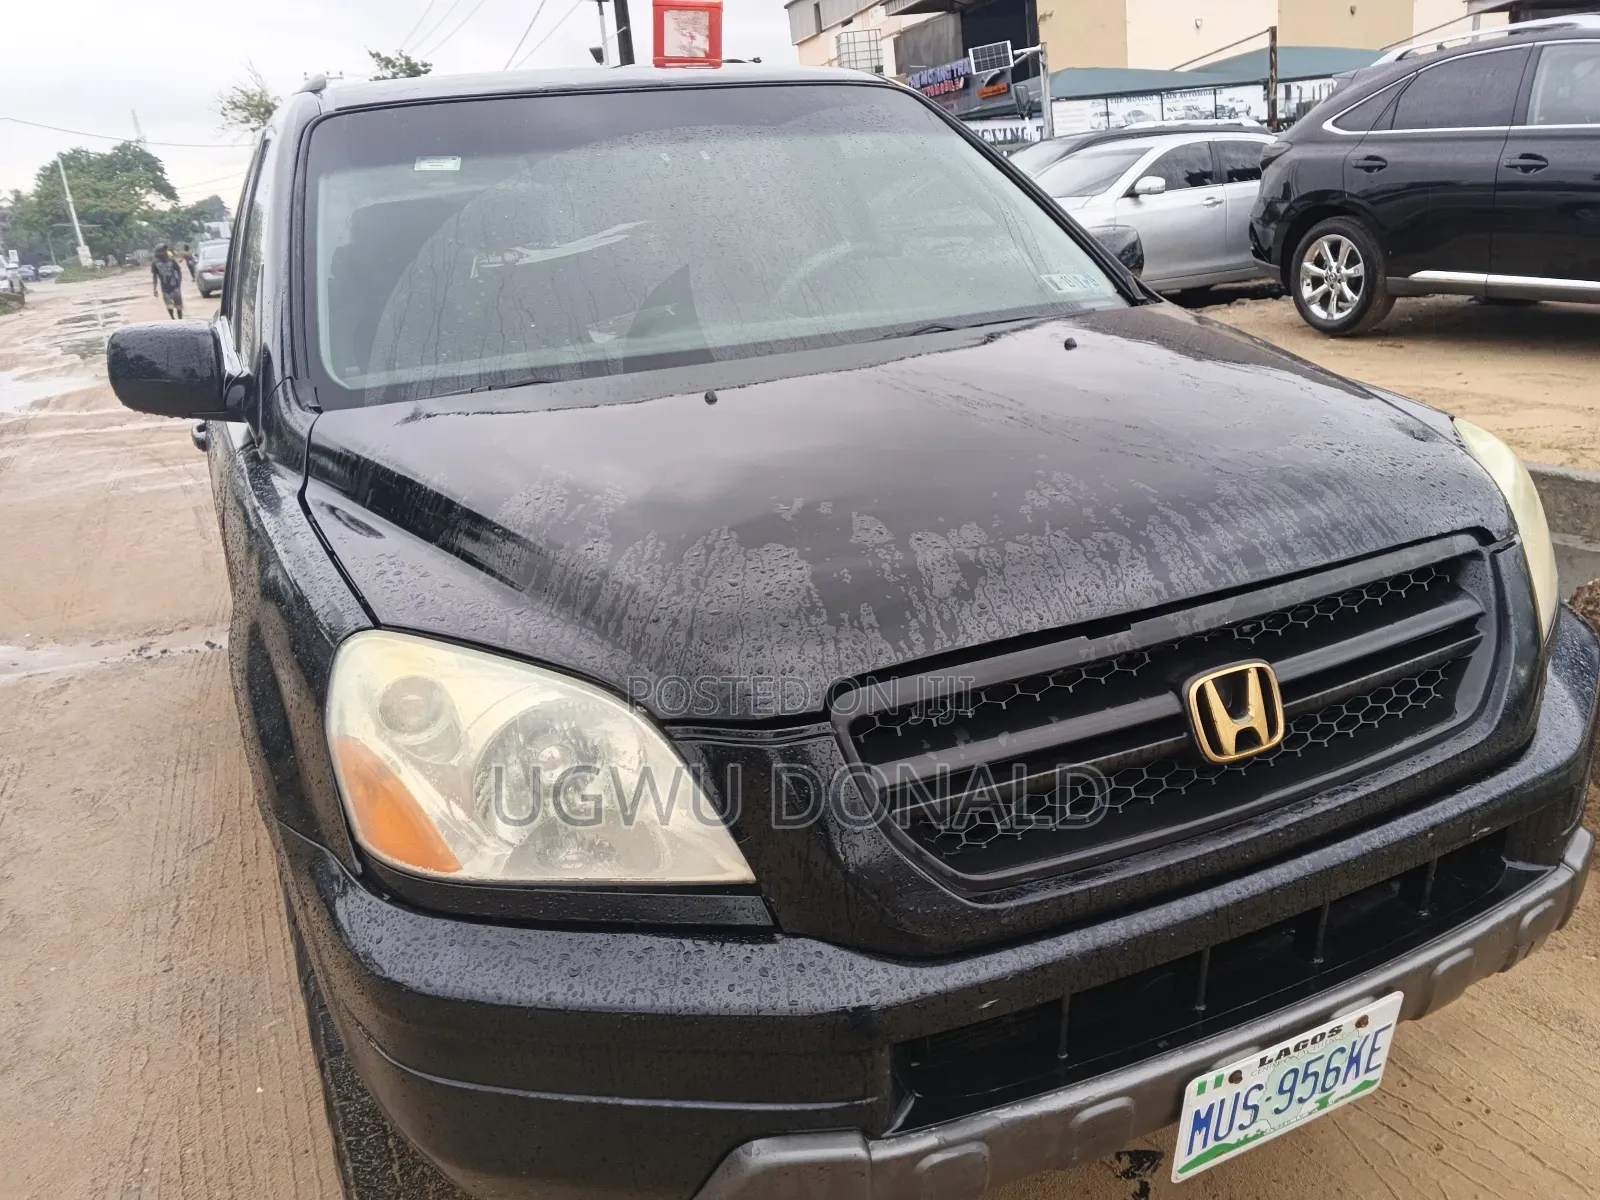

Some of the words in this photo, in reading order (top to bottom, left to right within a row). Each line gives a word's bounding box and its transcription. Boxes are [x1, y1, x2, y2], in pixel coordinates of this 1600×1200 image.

[951, 57, 972, 78] TRA
[1125, 95, 1154, 103] MOVING
[1258, 1024, 1344, 1068] LAGOS
[1187, 1023, 1392, 1157] MUS-956KE
